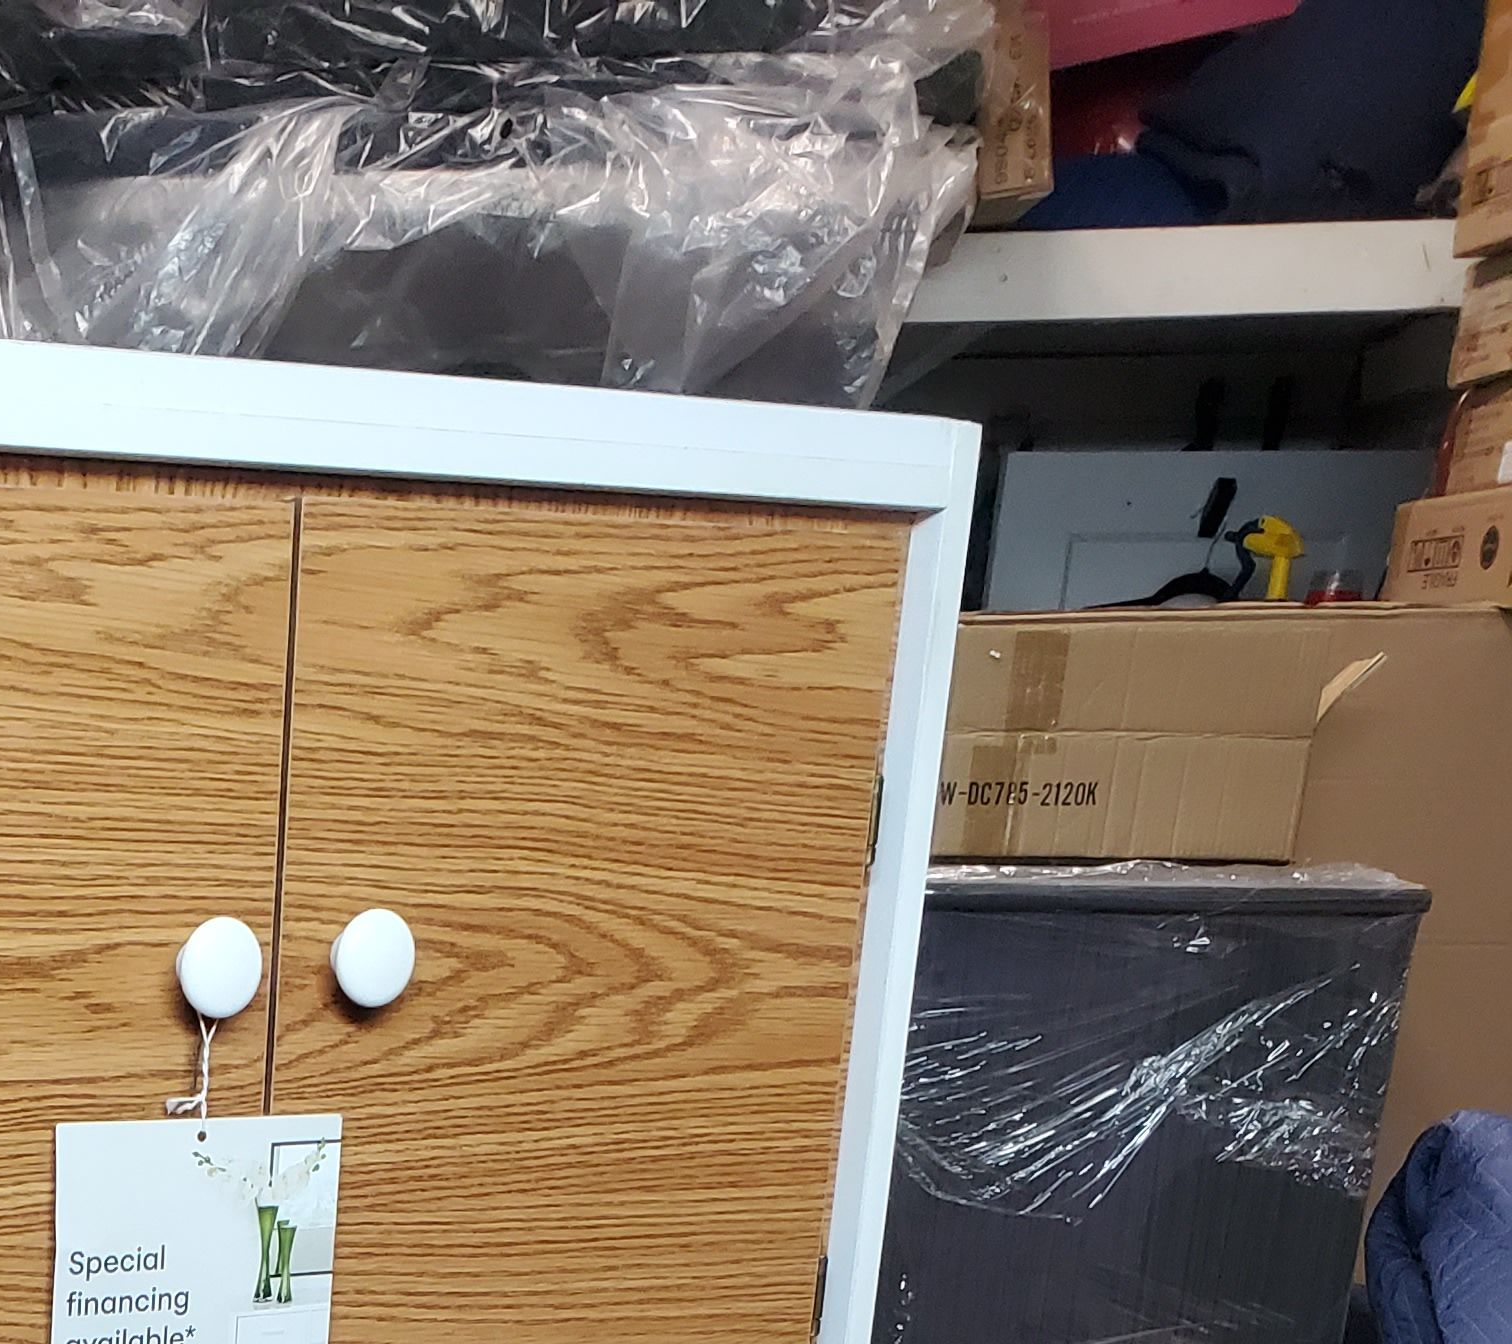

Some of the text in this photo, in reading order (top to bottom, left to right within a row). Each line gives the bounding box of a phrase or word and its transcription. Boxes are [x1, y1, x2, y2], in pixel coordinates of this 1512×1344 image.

[940, 781, 1100, 806] W-DC785-2120K
[69, 1244, 165, 1281] Special
[66, 1287, 189, 1316] financing
